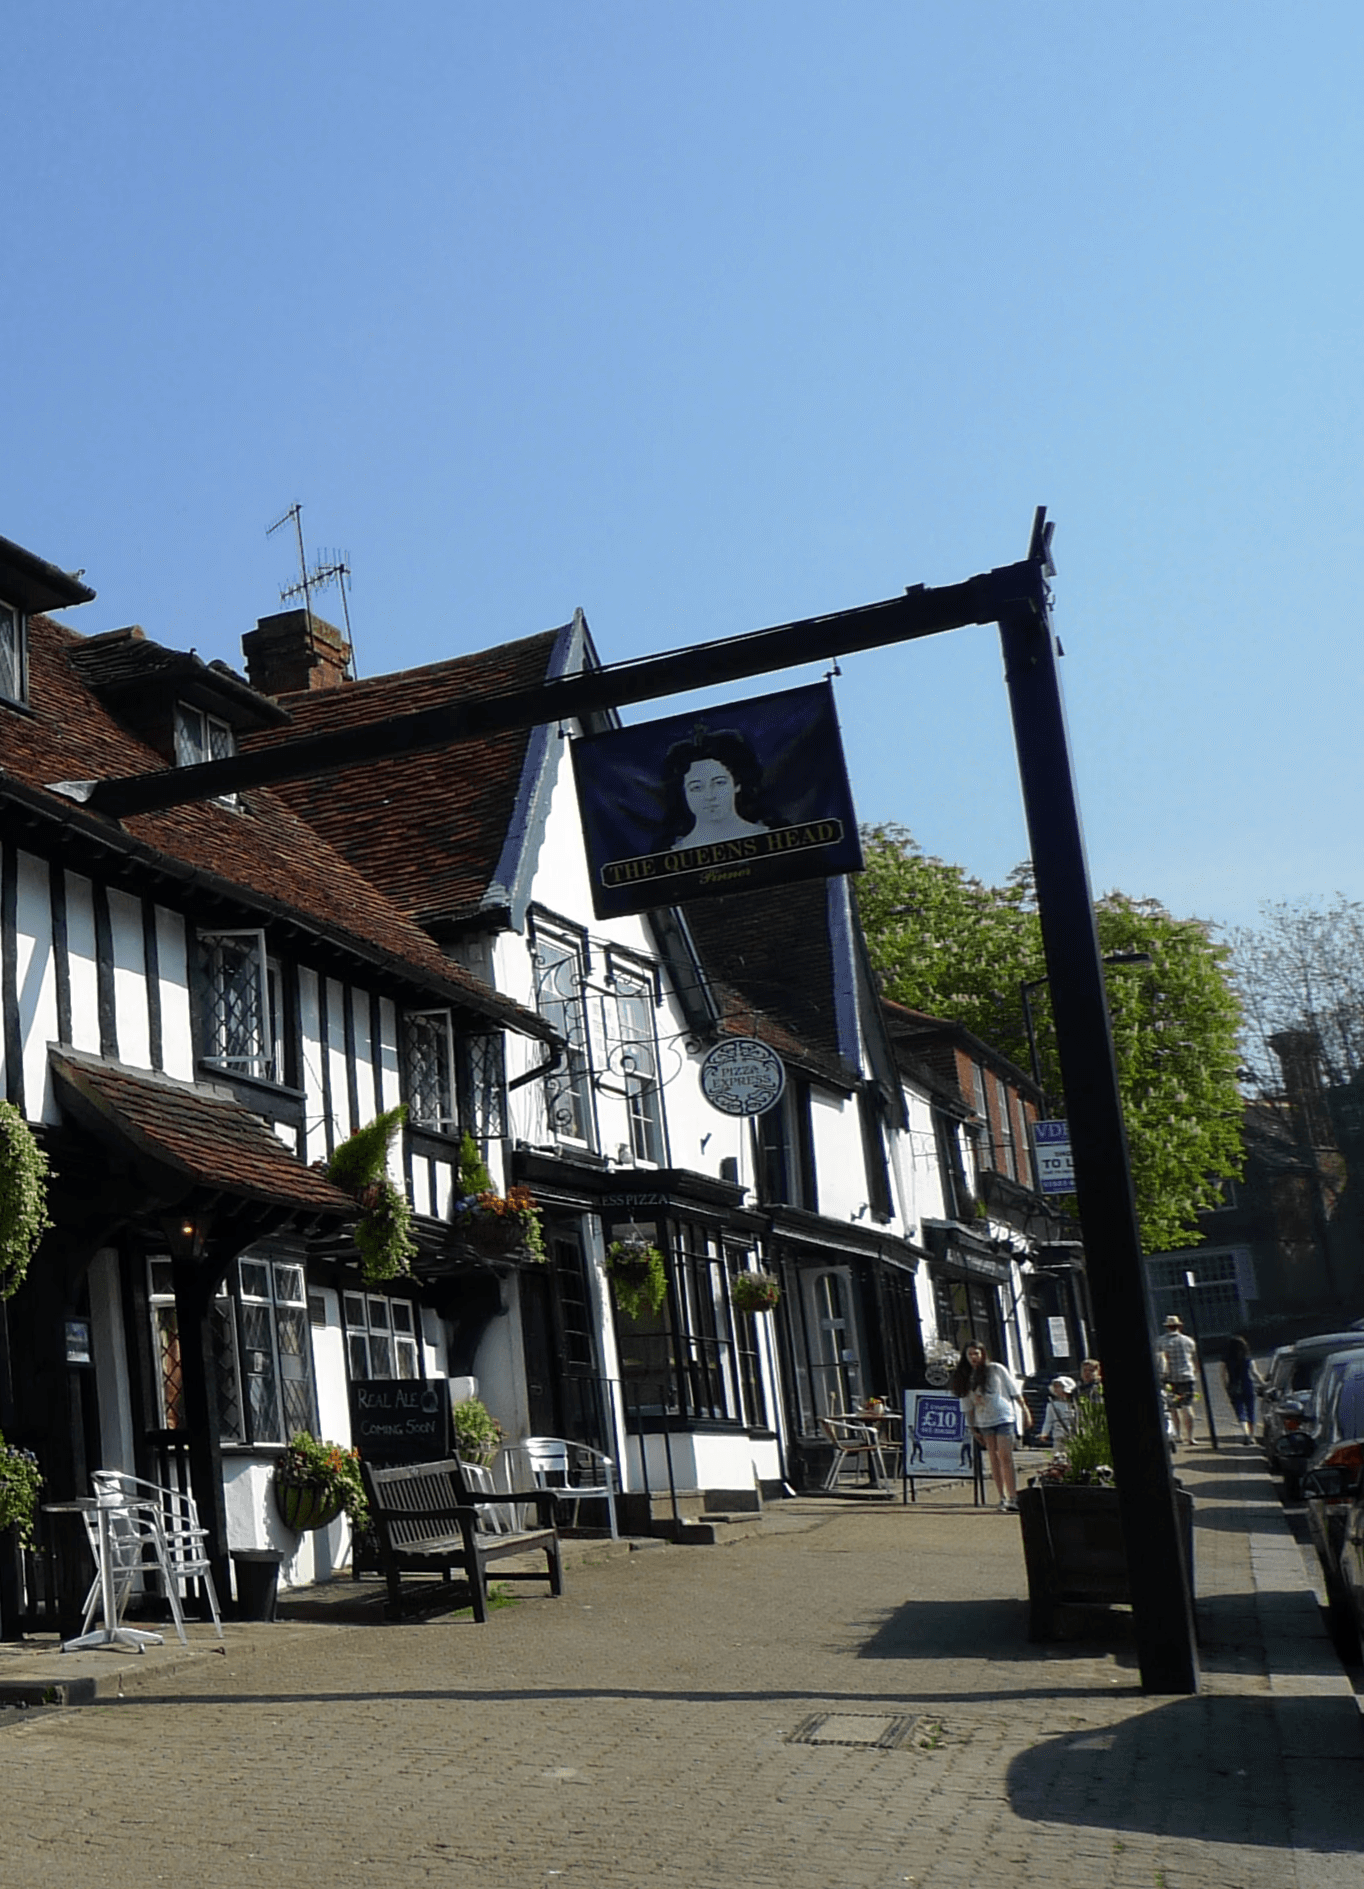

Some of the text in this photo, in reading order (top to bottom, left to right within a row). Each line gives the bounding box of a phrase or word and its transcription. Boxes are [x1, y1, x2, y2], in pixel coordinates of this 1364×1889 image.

[609, 823, 834, 882] THE QUEENS HEAD
[721, 1065, 759, 1077] PIZZA
[712, 1074, 772, 1088] EXPRESS
[1042, 1158, 1061, 1169] TO
[357, 1387, 419, 1410] REAL ALE
[360, 1418, 436, 1436] COMING SOON
[920, 1410, 957, 1428] £10
